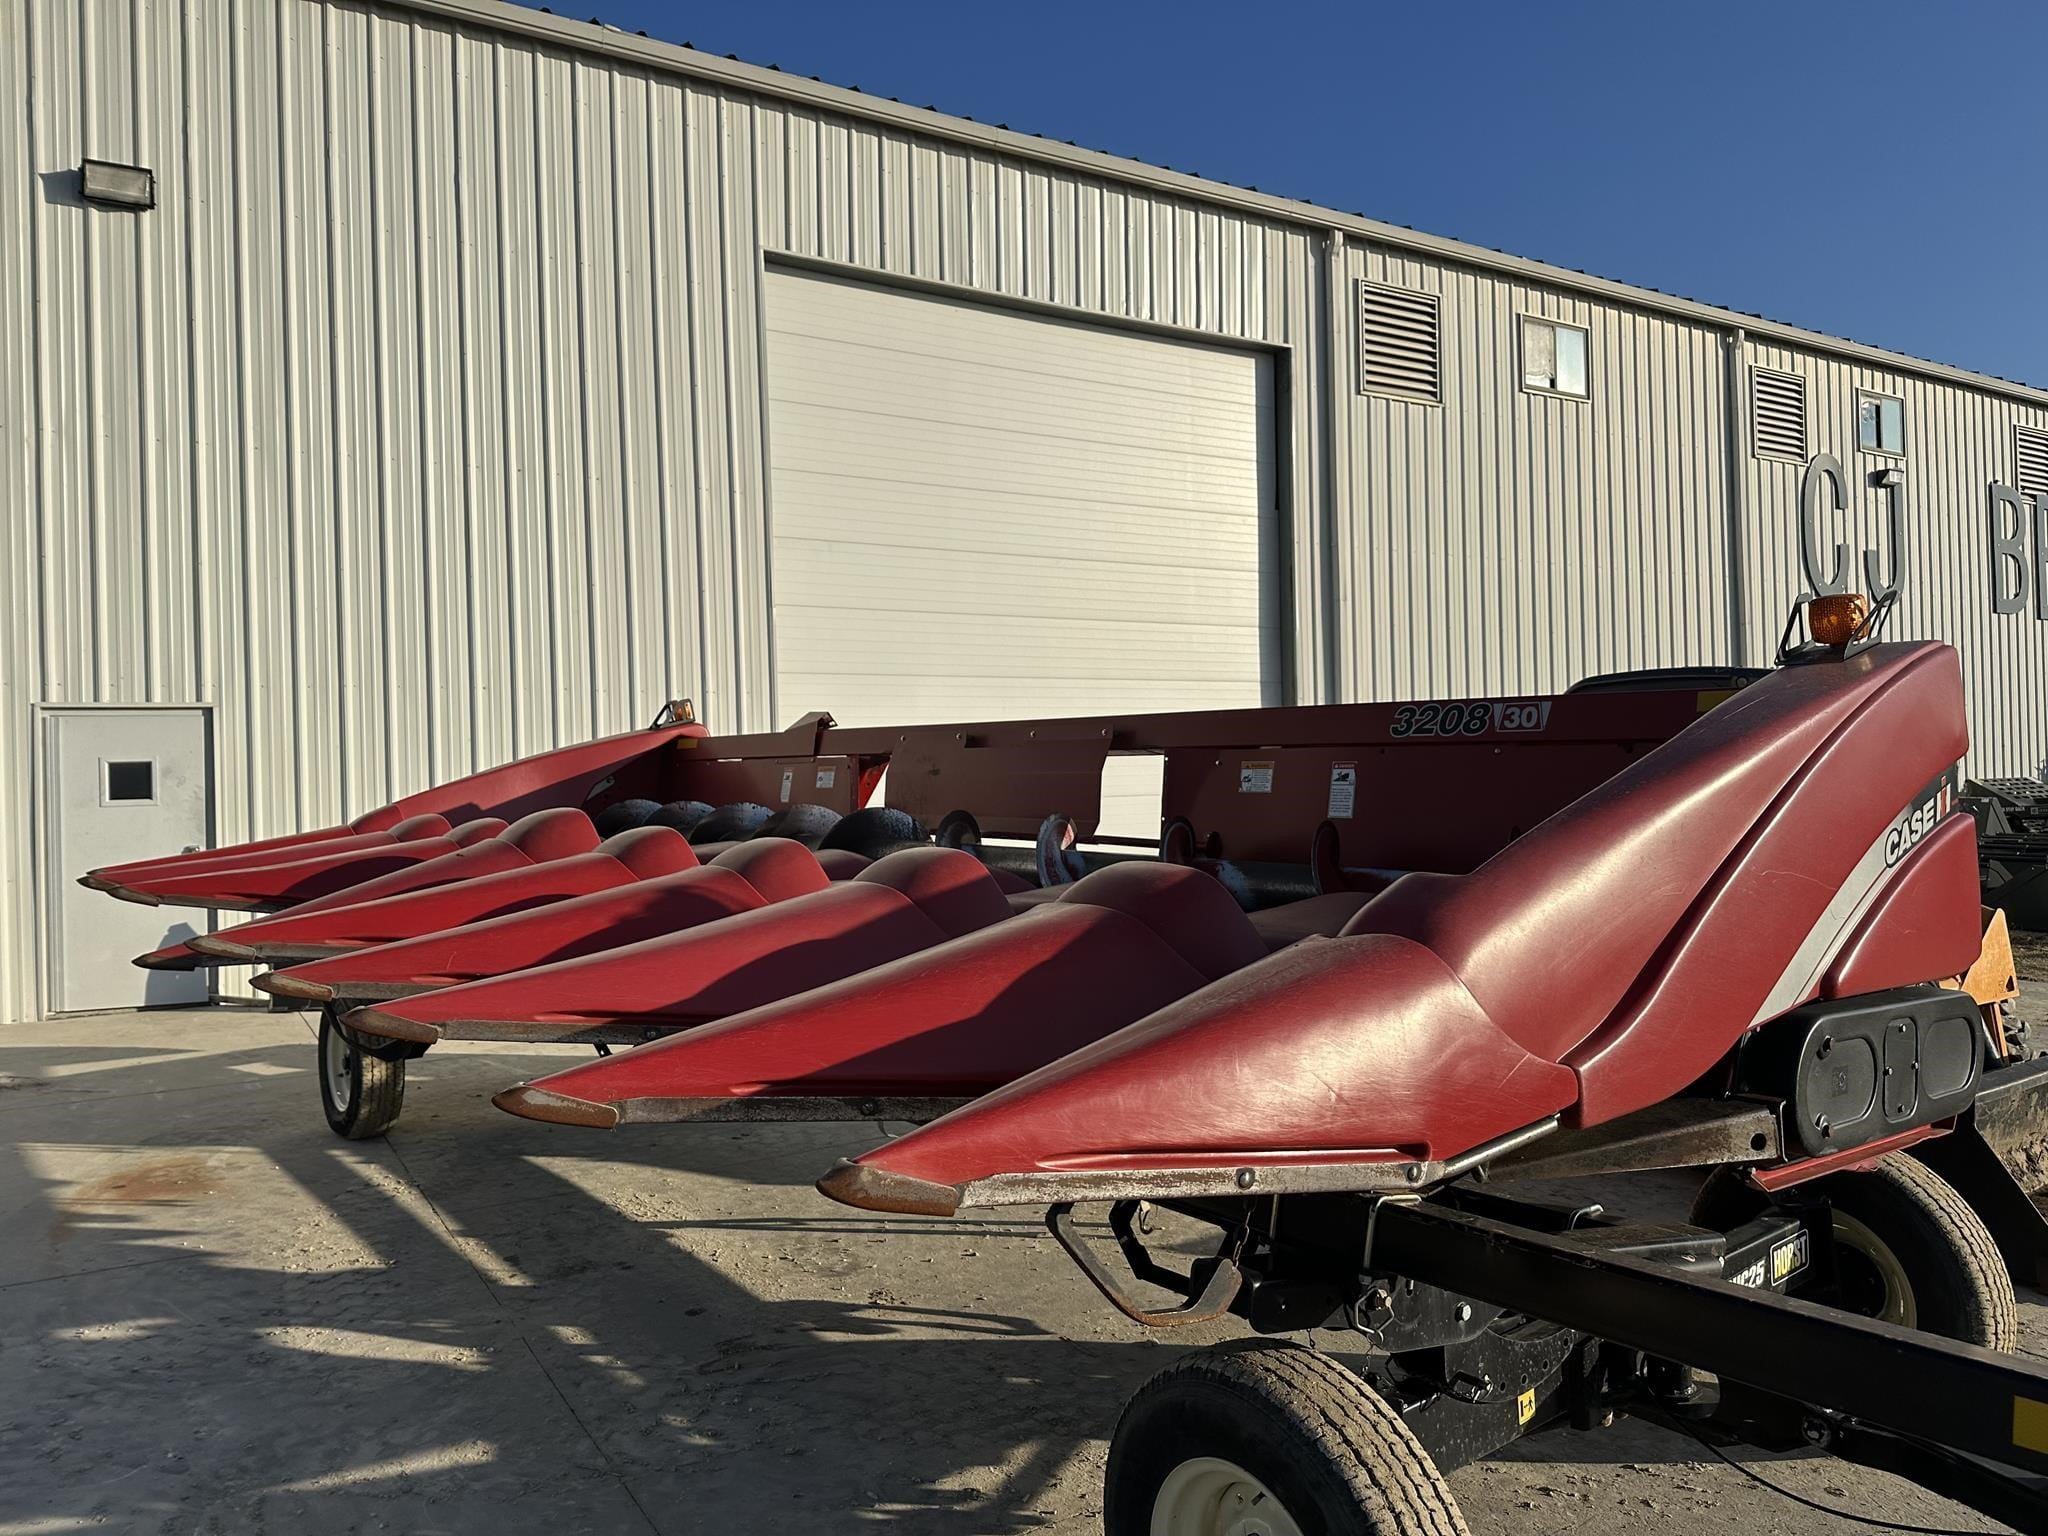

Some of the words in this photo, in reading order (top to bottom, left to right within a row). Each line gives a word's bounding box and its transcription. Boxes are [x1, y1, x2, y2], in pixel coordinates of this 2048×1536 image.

[1803, 452, 1906, 607] CJ
[1389, 702, 1492, 737] 3208
[1503, 706, 1538, 729] 30
[1885, 797, 1935, 866] CASE
[1773, 1235, 1807, 1279] HORST
